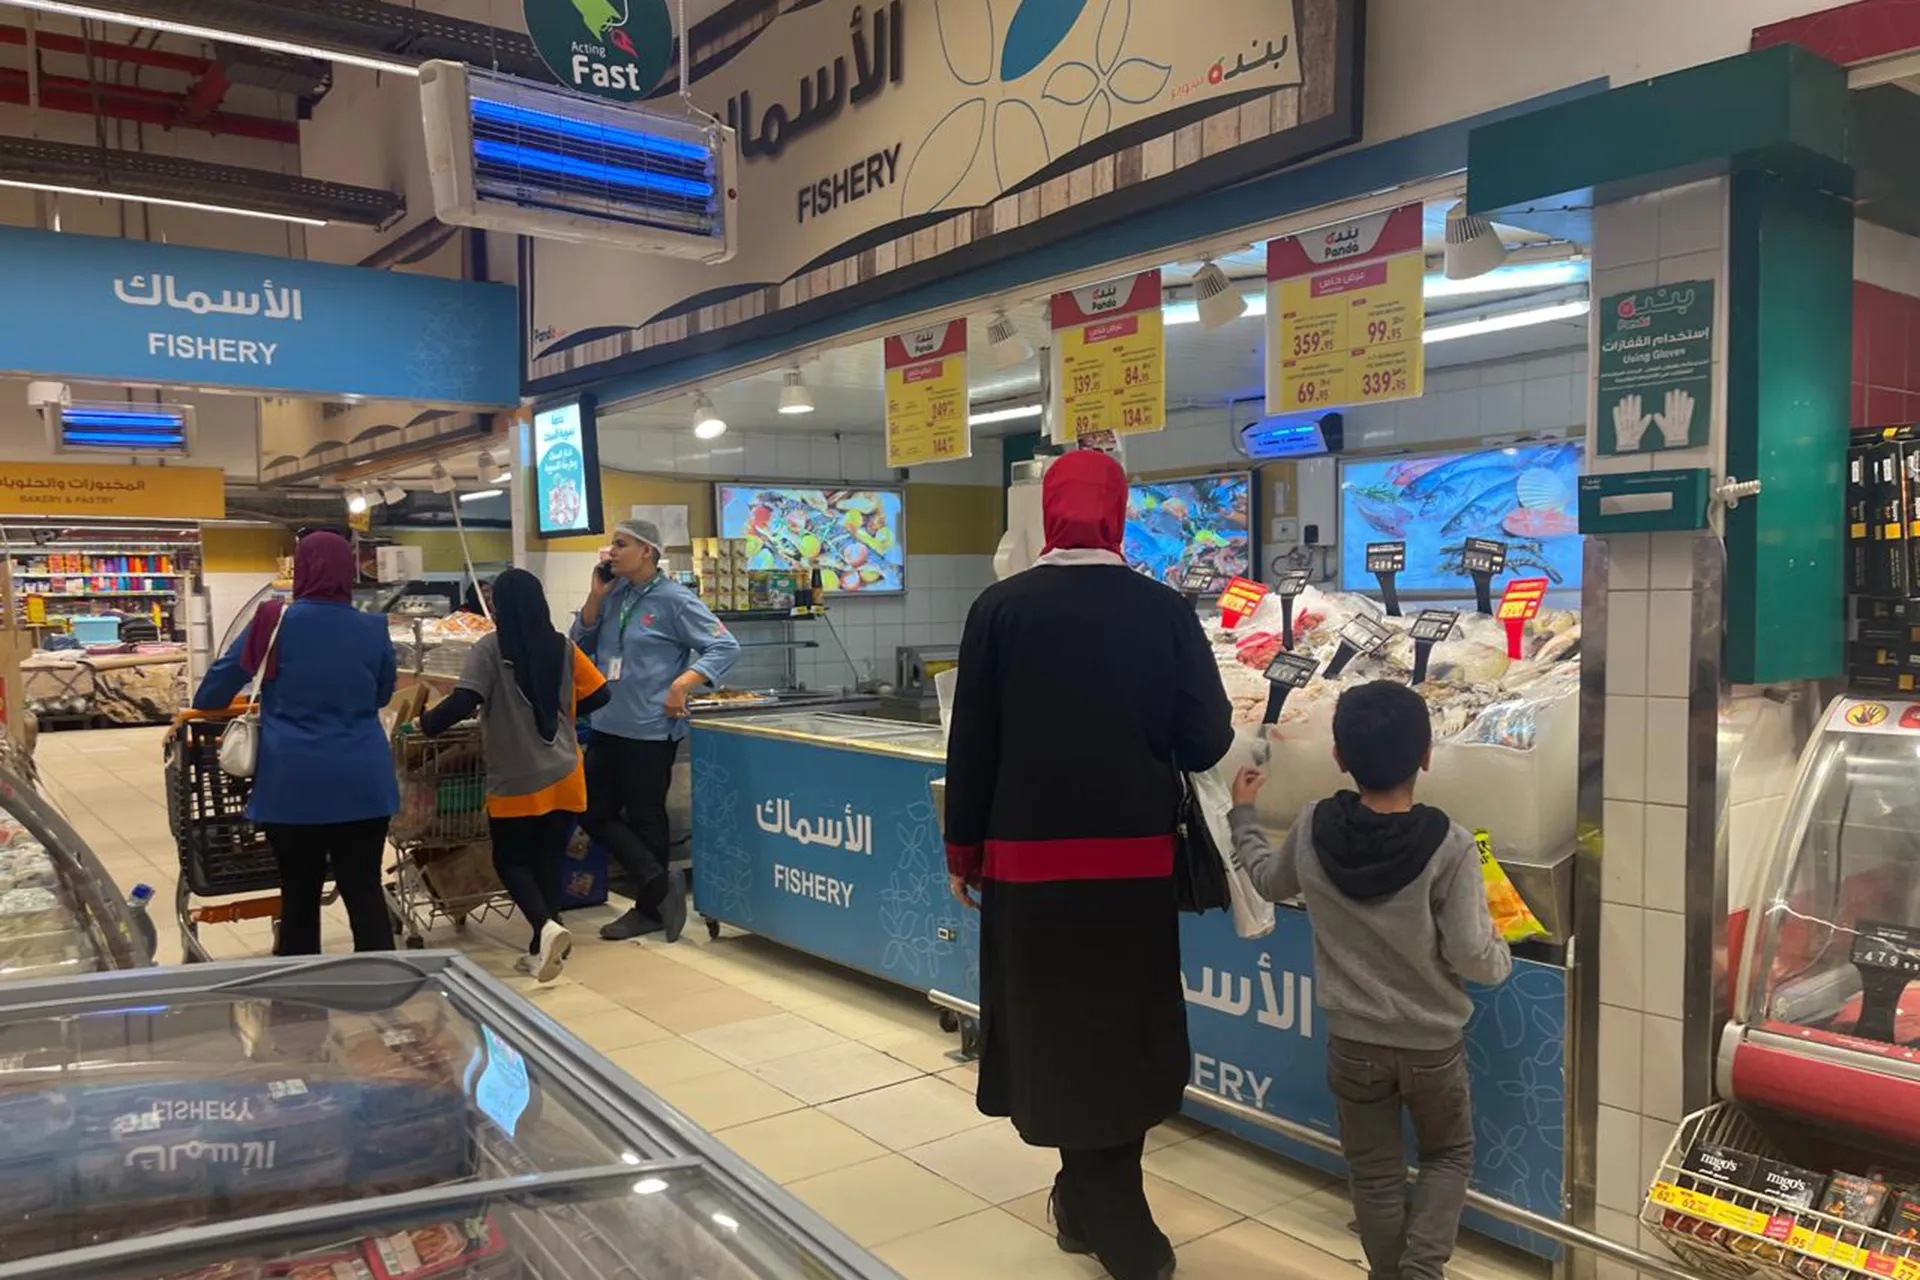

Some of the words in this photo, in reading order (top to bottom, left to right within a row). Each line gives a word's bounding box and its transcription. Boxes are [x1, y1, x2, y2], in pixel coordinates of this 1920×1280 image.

[571, 41, 606, 58] Acting
[572, 54, 641, 92] Fast
[798, 143, 901, 223] FISHERY
[1325, 243, 1360, 258] Panda
[113, 274, 302, 320] الأسماك
[148, 332, 278, 365] FISHERY
[1623, 352, 1651, 364] Using
[1652, 348, 1686, 360] Gloves
[20, 494, 62, 504] BAKERY
[75, 495, 115, 504] PASTRY
[756, 798, 872, 855] الأسماك
[774, 864, 854, 908] FISHERY
[1181, 952, 1312, 1038] الأس
[1194, 1052, 1273, 1108] ERY
